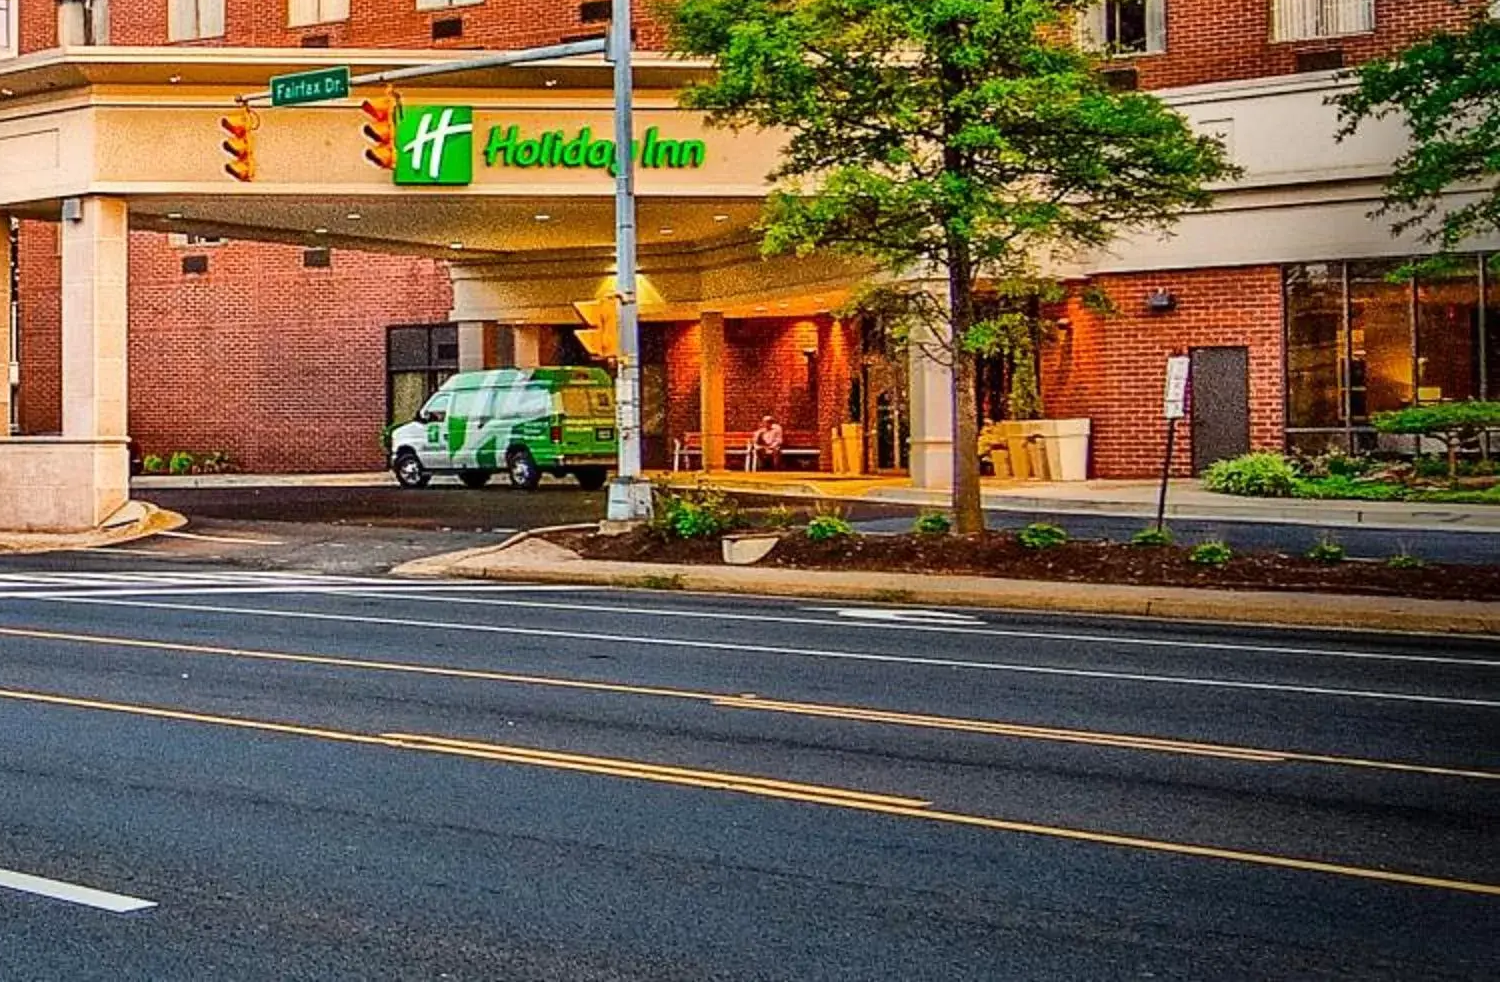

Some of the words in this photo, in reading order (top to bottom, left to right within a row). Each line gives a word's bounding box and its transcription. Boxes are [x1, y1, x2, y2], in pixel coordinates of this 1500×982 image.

[276, 80, 321, 99] Fairfax
[325, 78, 345, 94] Dr.
[642, 126, 706, 169] Inn
